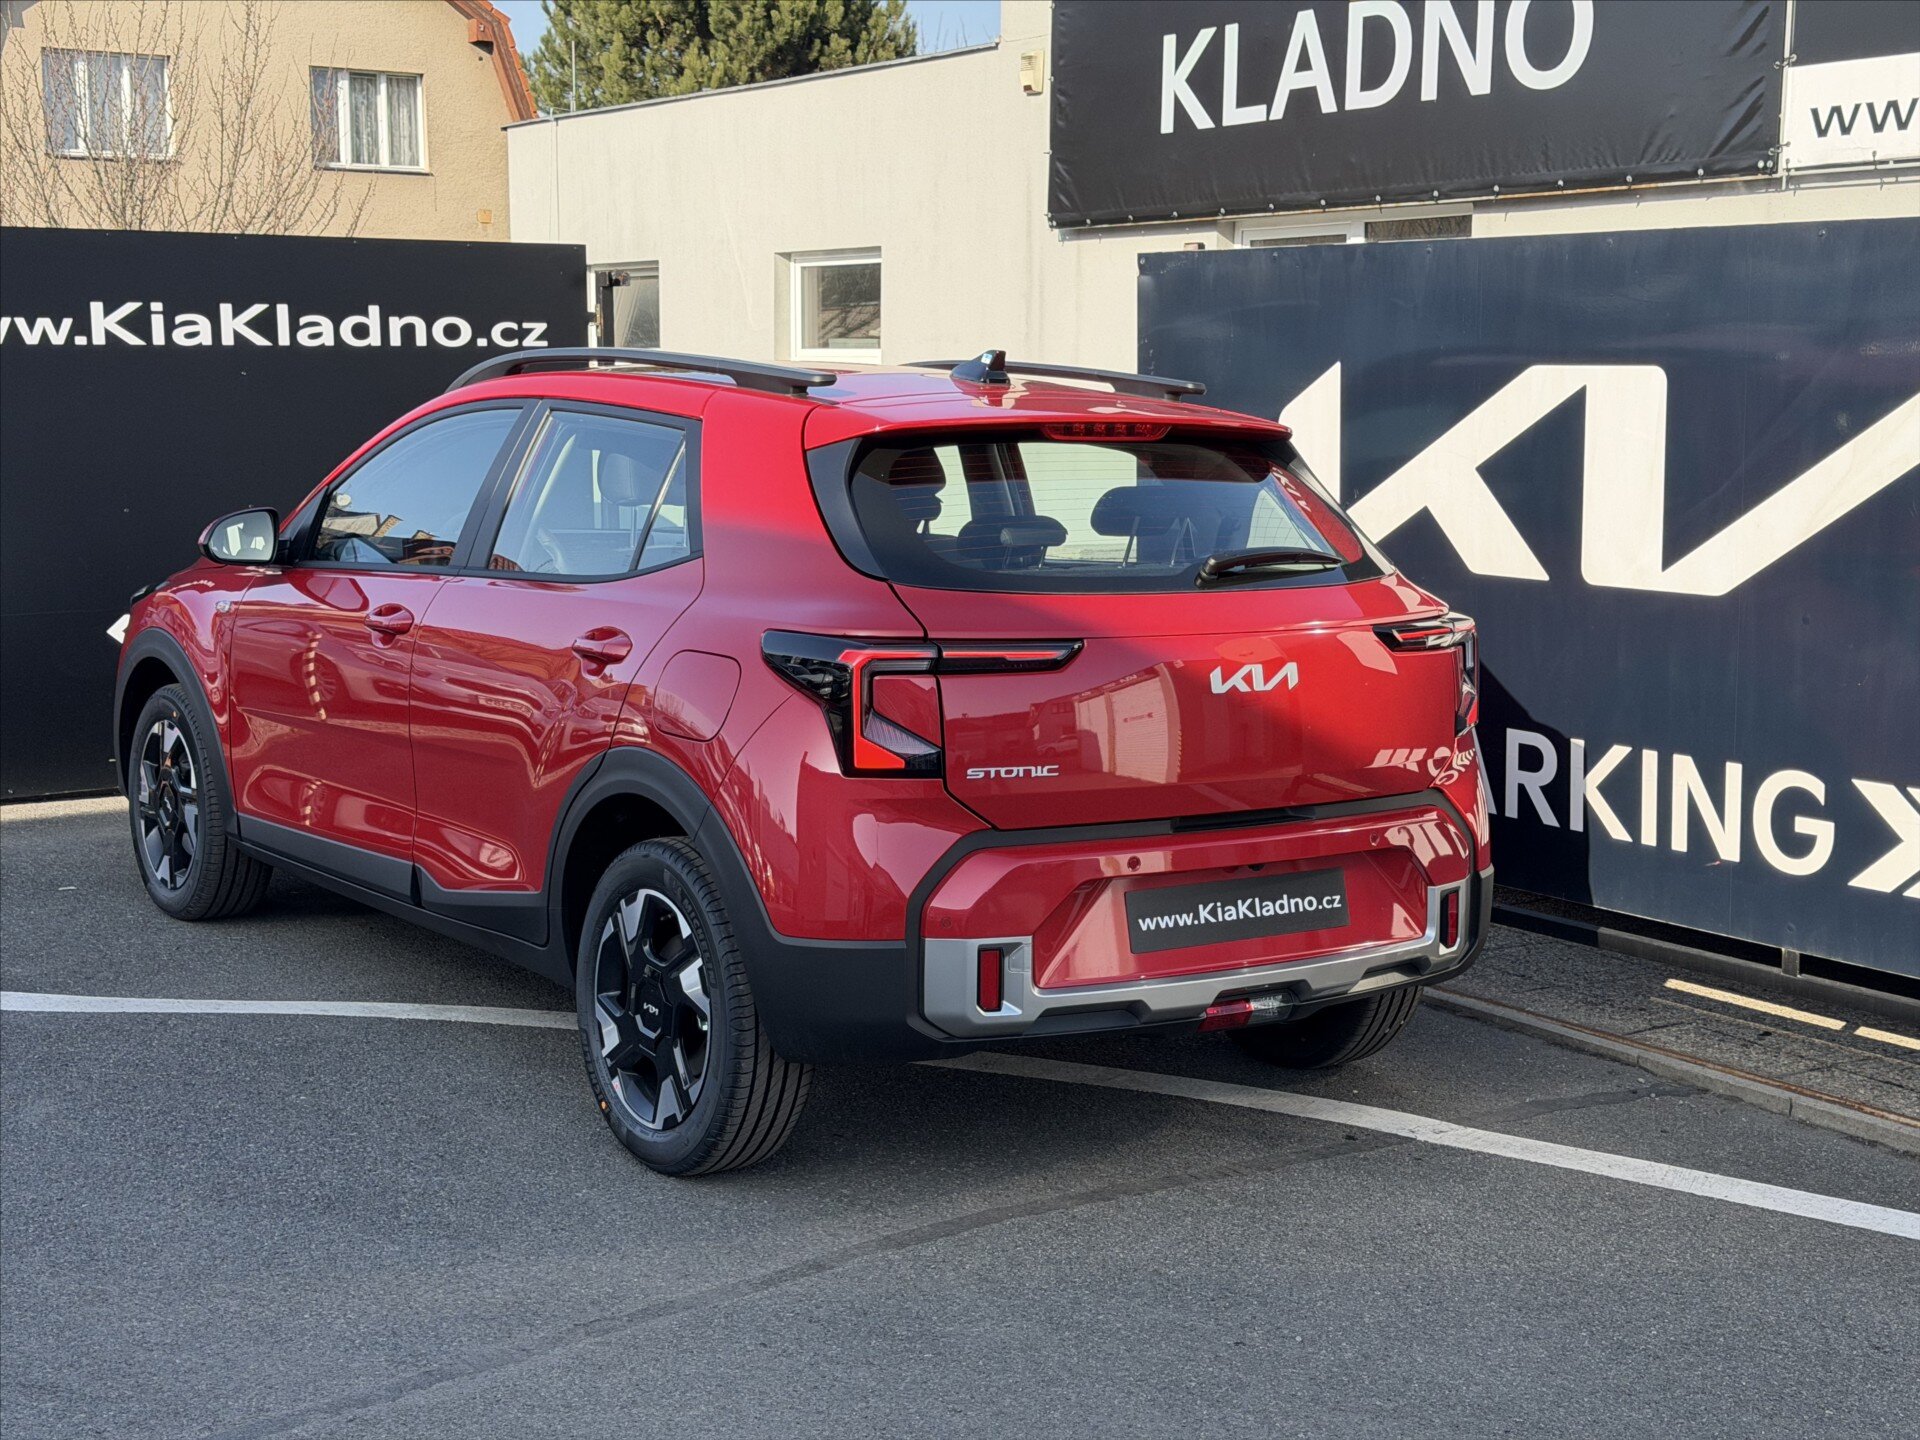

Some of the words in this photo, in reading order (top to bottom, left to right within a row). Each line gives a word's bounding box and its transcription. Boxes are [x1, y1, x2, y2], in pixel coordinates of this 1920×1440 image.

[1160, 0, 1595, 134] KLADNO
[1210, 661, 1299, 695] KIA
[966, 764, 1060, 780] STONIC
[1137, 894, 1342, 932] www.KiaKladno.cz
